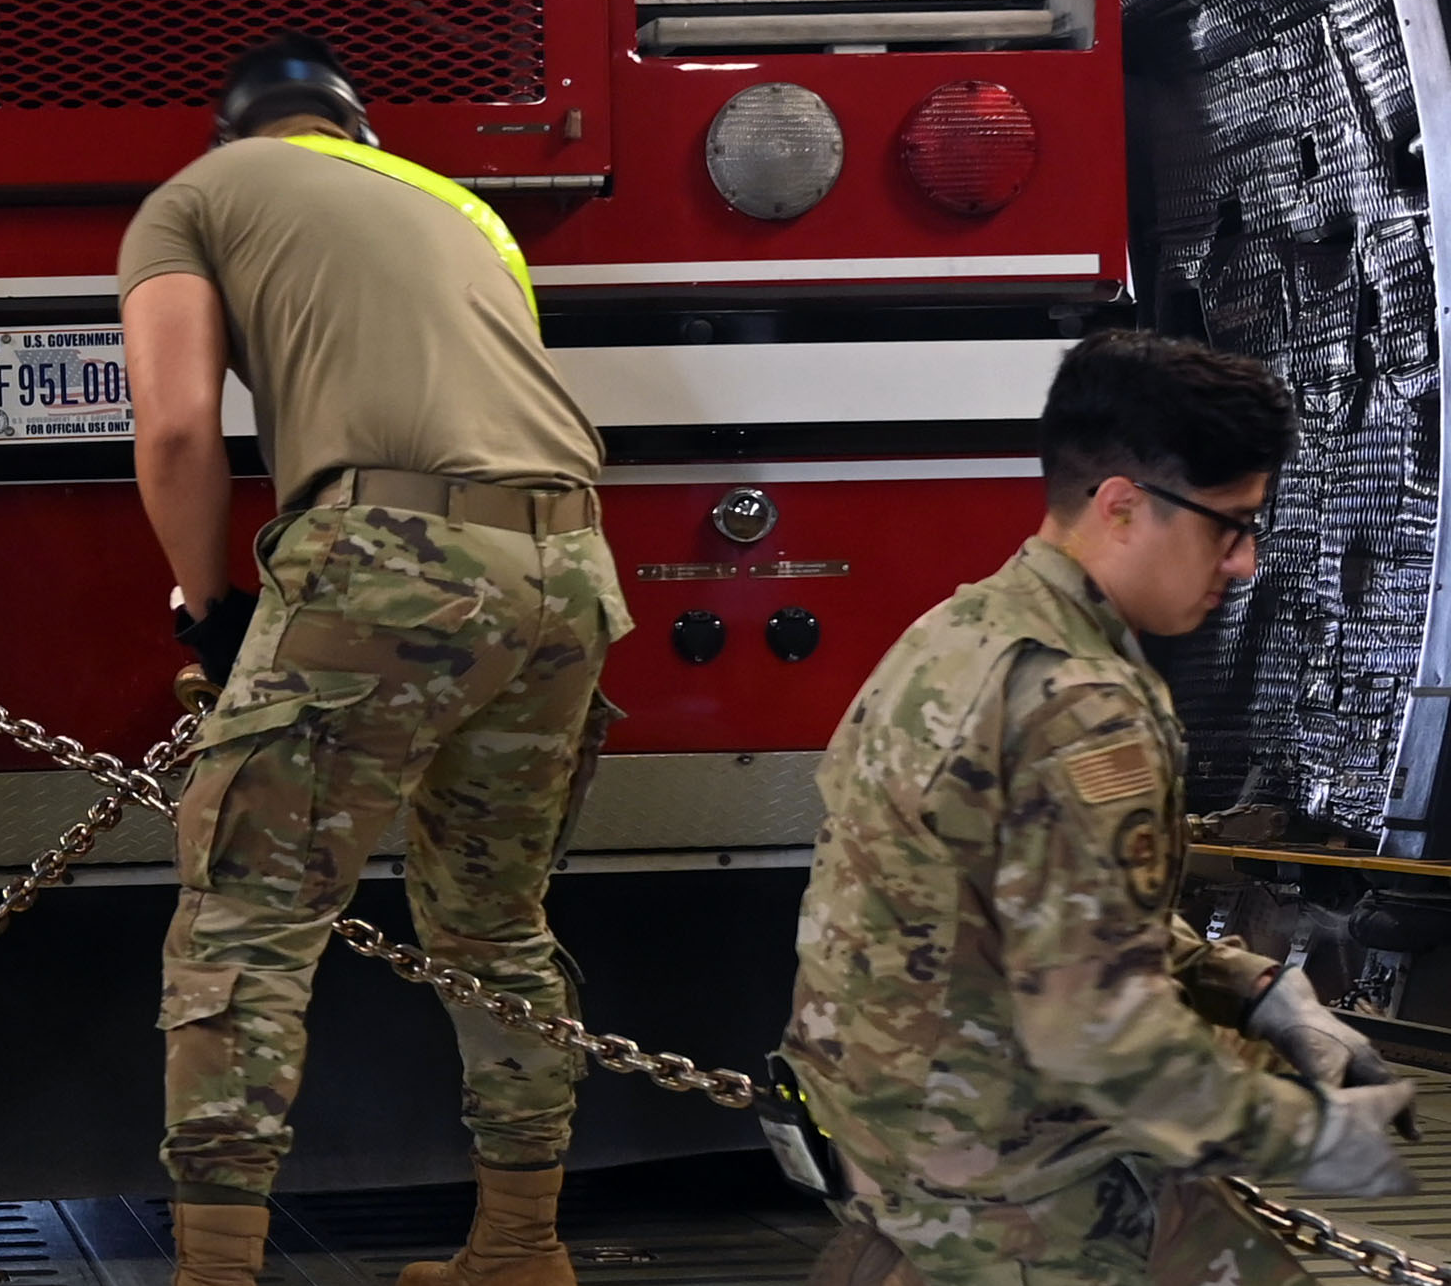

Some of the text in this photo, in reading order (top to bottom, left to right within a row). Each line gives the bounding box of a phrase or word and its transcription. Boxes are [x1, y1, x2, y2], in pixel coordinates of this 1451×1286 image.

[23, 334, 45, 348] U.S.
[26, 422, 131, 435] FOR OFFICIAL USE ONLY
